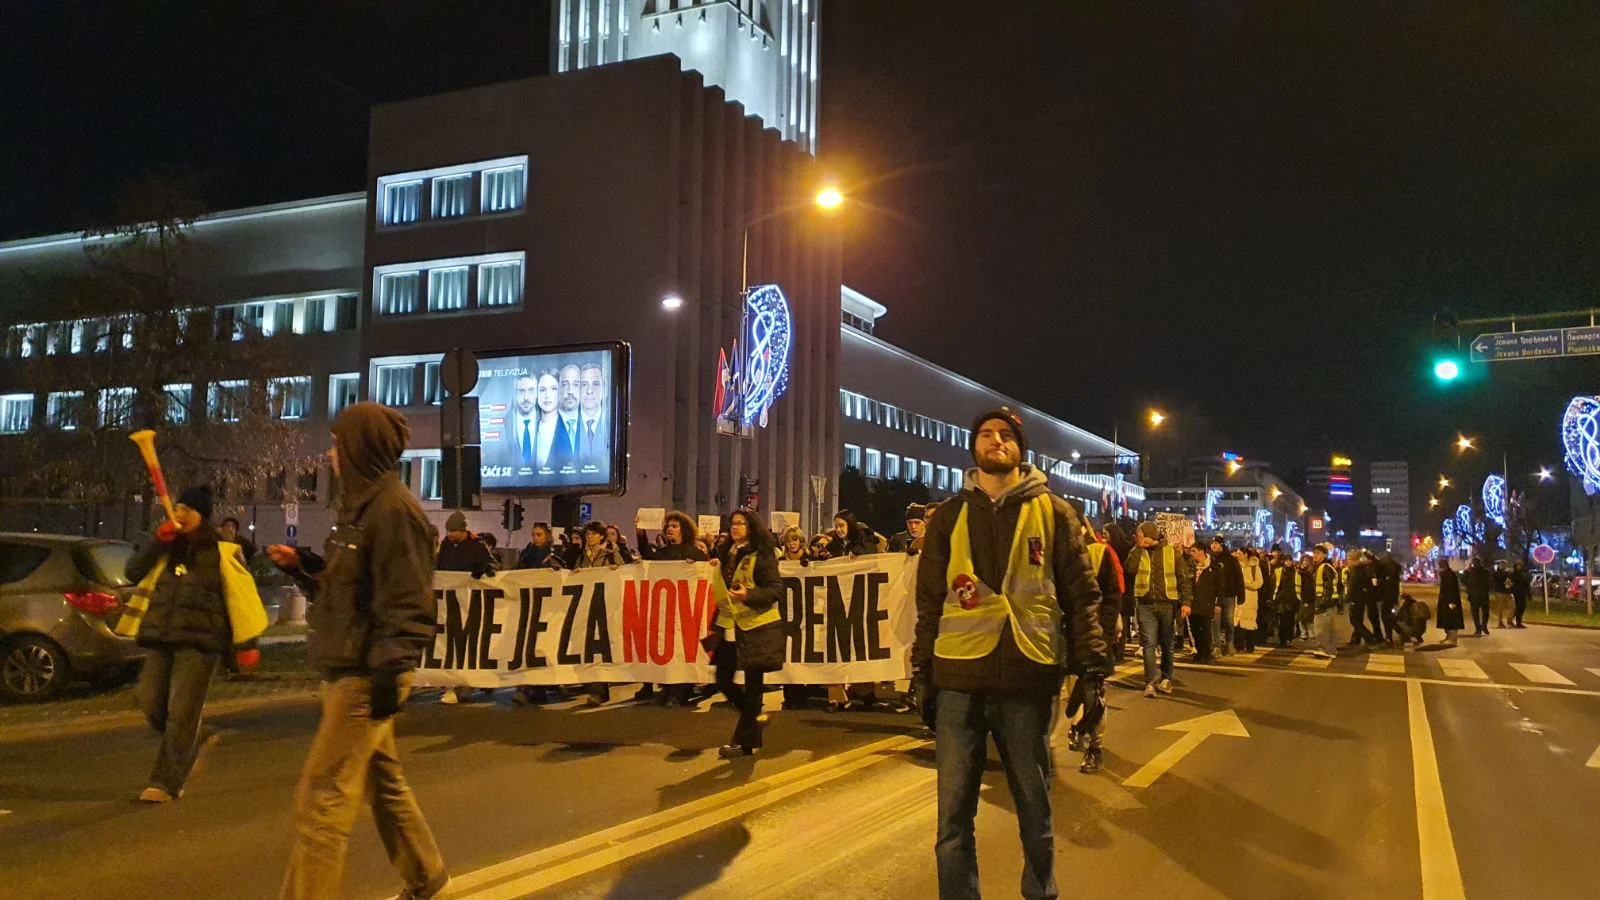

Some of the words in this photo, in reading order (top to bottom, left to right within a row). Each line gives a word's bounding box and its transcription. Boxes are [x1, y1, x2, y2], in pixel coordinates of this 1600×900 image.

[494, 368, 528, 377] TELEVIZIJA
[579, 504, 588, 516] P
[418, 588, 505, 670] EME
[507, 587, 553, 671] JE
[557, 582, 613, 665] ZA
